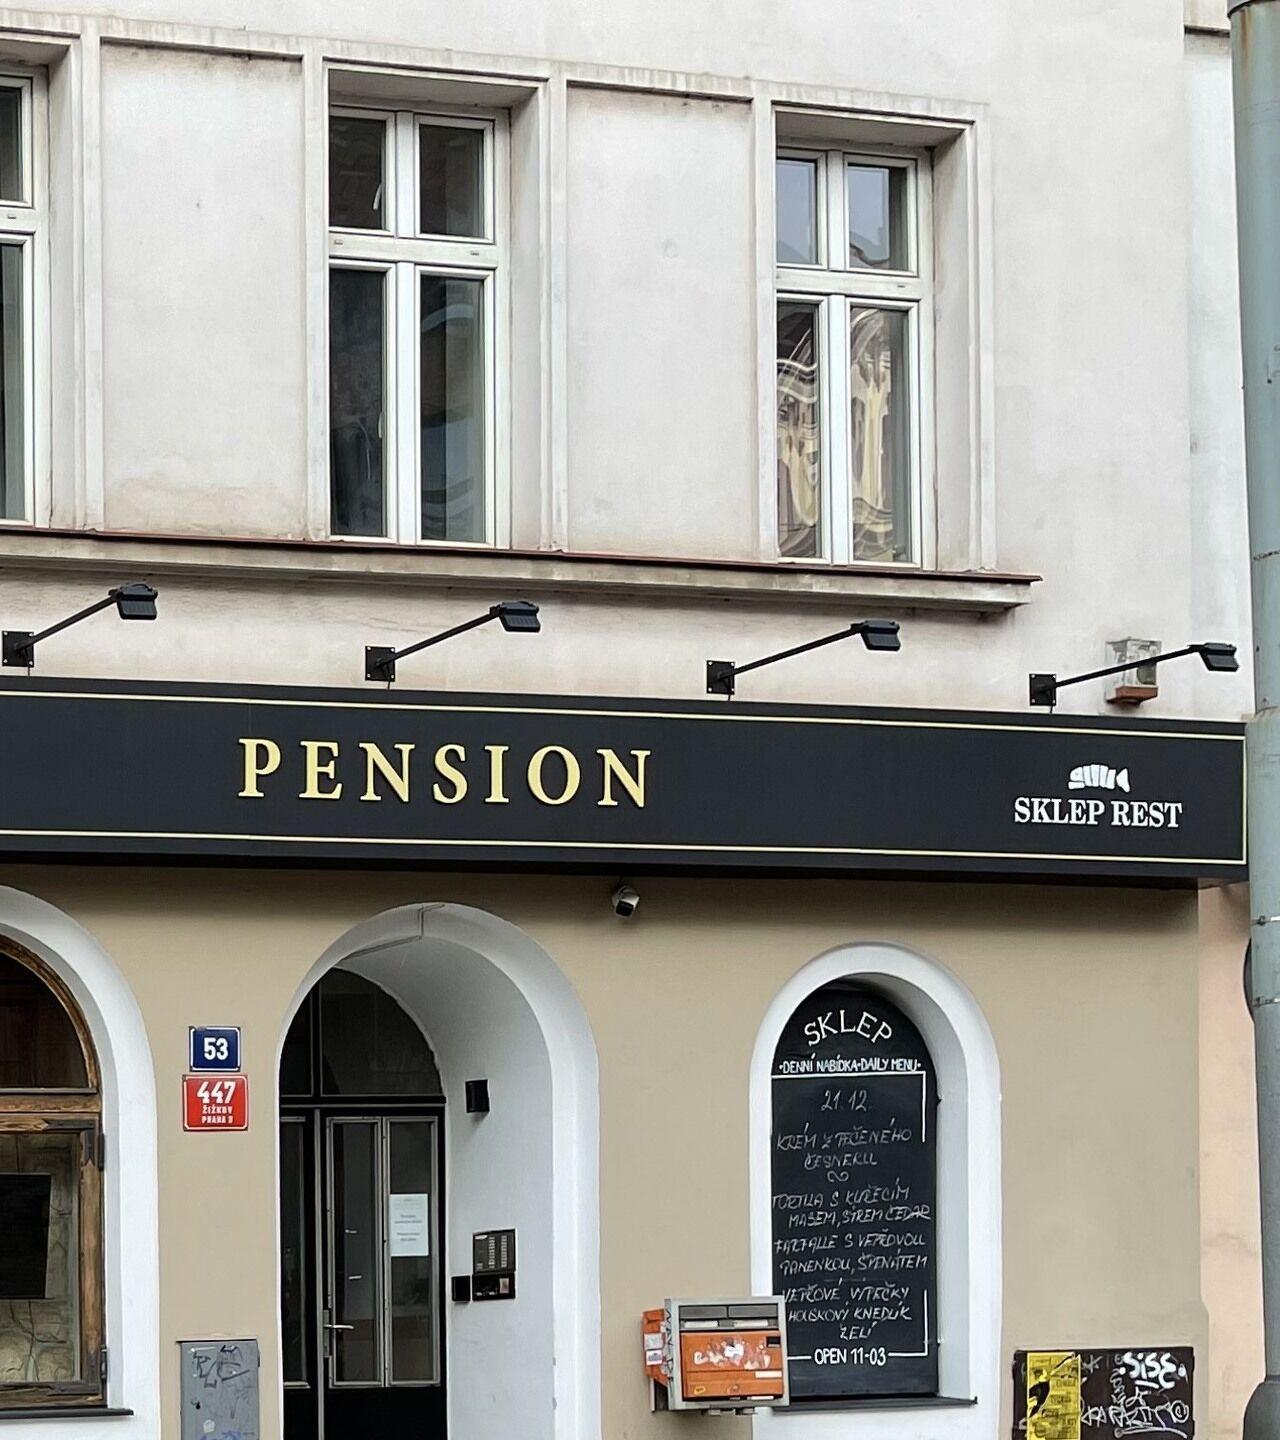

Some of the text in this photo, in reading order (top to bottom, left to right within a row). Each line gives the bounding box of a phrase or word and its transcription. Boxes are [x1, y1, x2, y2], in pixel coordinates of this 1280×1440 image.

[238, 738, 652, 808] PENSION
[1014, 796, 1183, 829] SKLEP REST
[803, 1009, 893, 1047] SKLEP
[203, 1037, 229, 1061] 53
[816, 1054, 858, 1072] NABÍDKA
[860, 1058, 889, 1072] DAILY
[891, 1057, 918, 1072] MENU
[196, 1081, 237, 1104] 447
[201, 1115, 233, 1124] PRAHA 3
[202, 1104, 233, 1114] ŽIŽKOV
[854, 1301, 912, 1321] KNEDLÍK
[814, 1347, 887, 1366] OPEN 11-03
